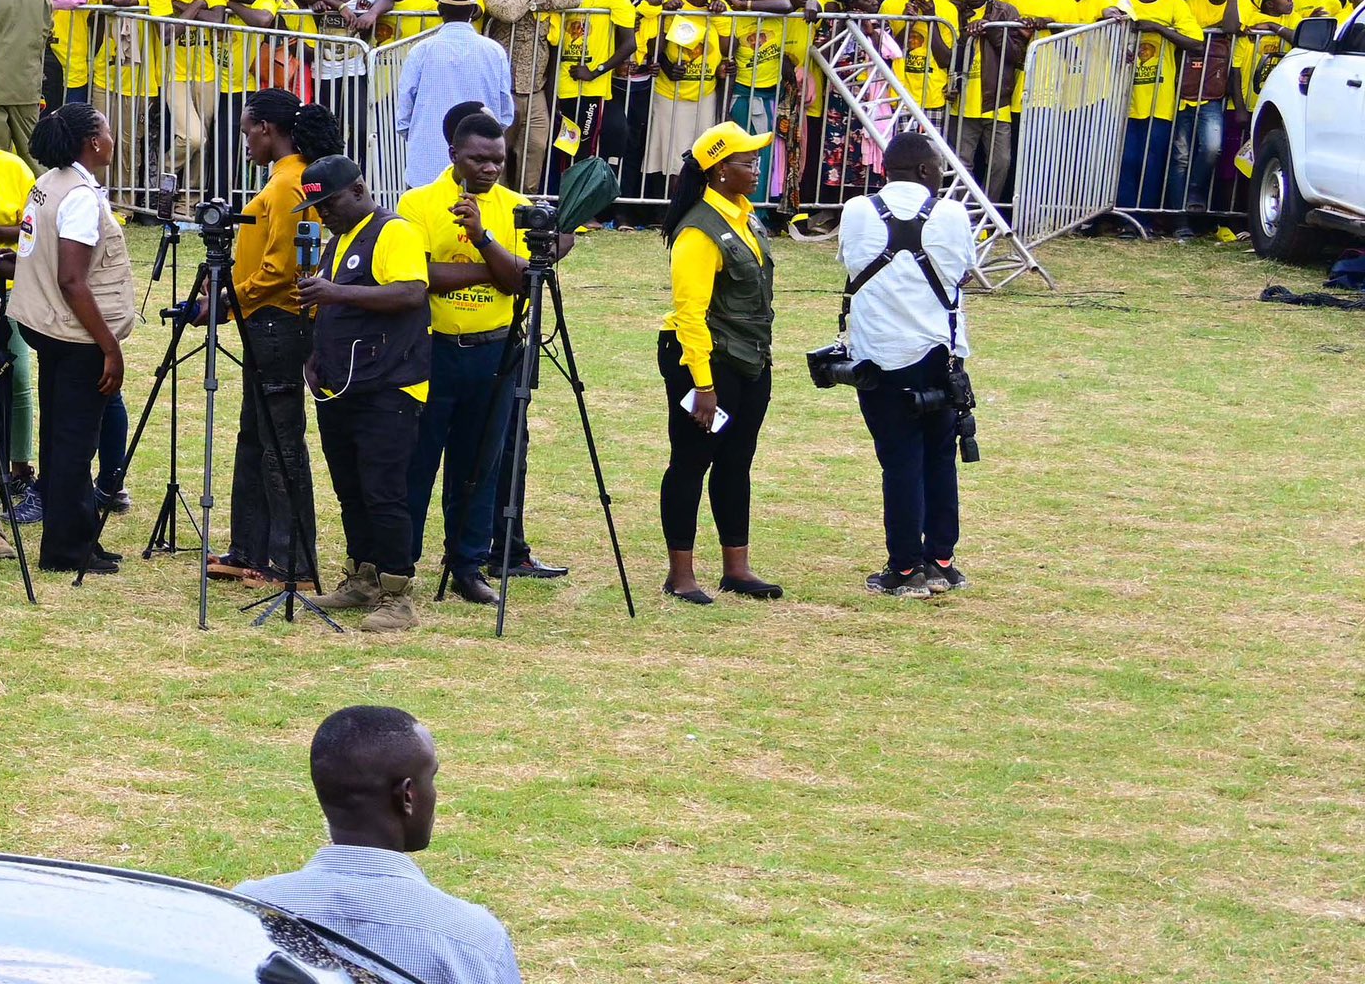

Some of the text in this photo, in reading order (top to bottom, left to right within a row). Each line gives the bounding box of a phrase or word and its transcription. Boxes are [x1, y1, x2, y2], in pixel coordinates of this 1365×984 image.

[582, 103, 598, 137] Supreme
[707, 139, 726, 158] NRM
[438, 291, 494, 303] MUSEVENI
